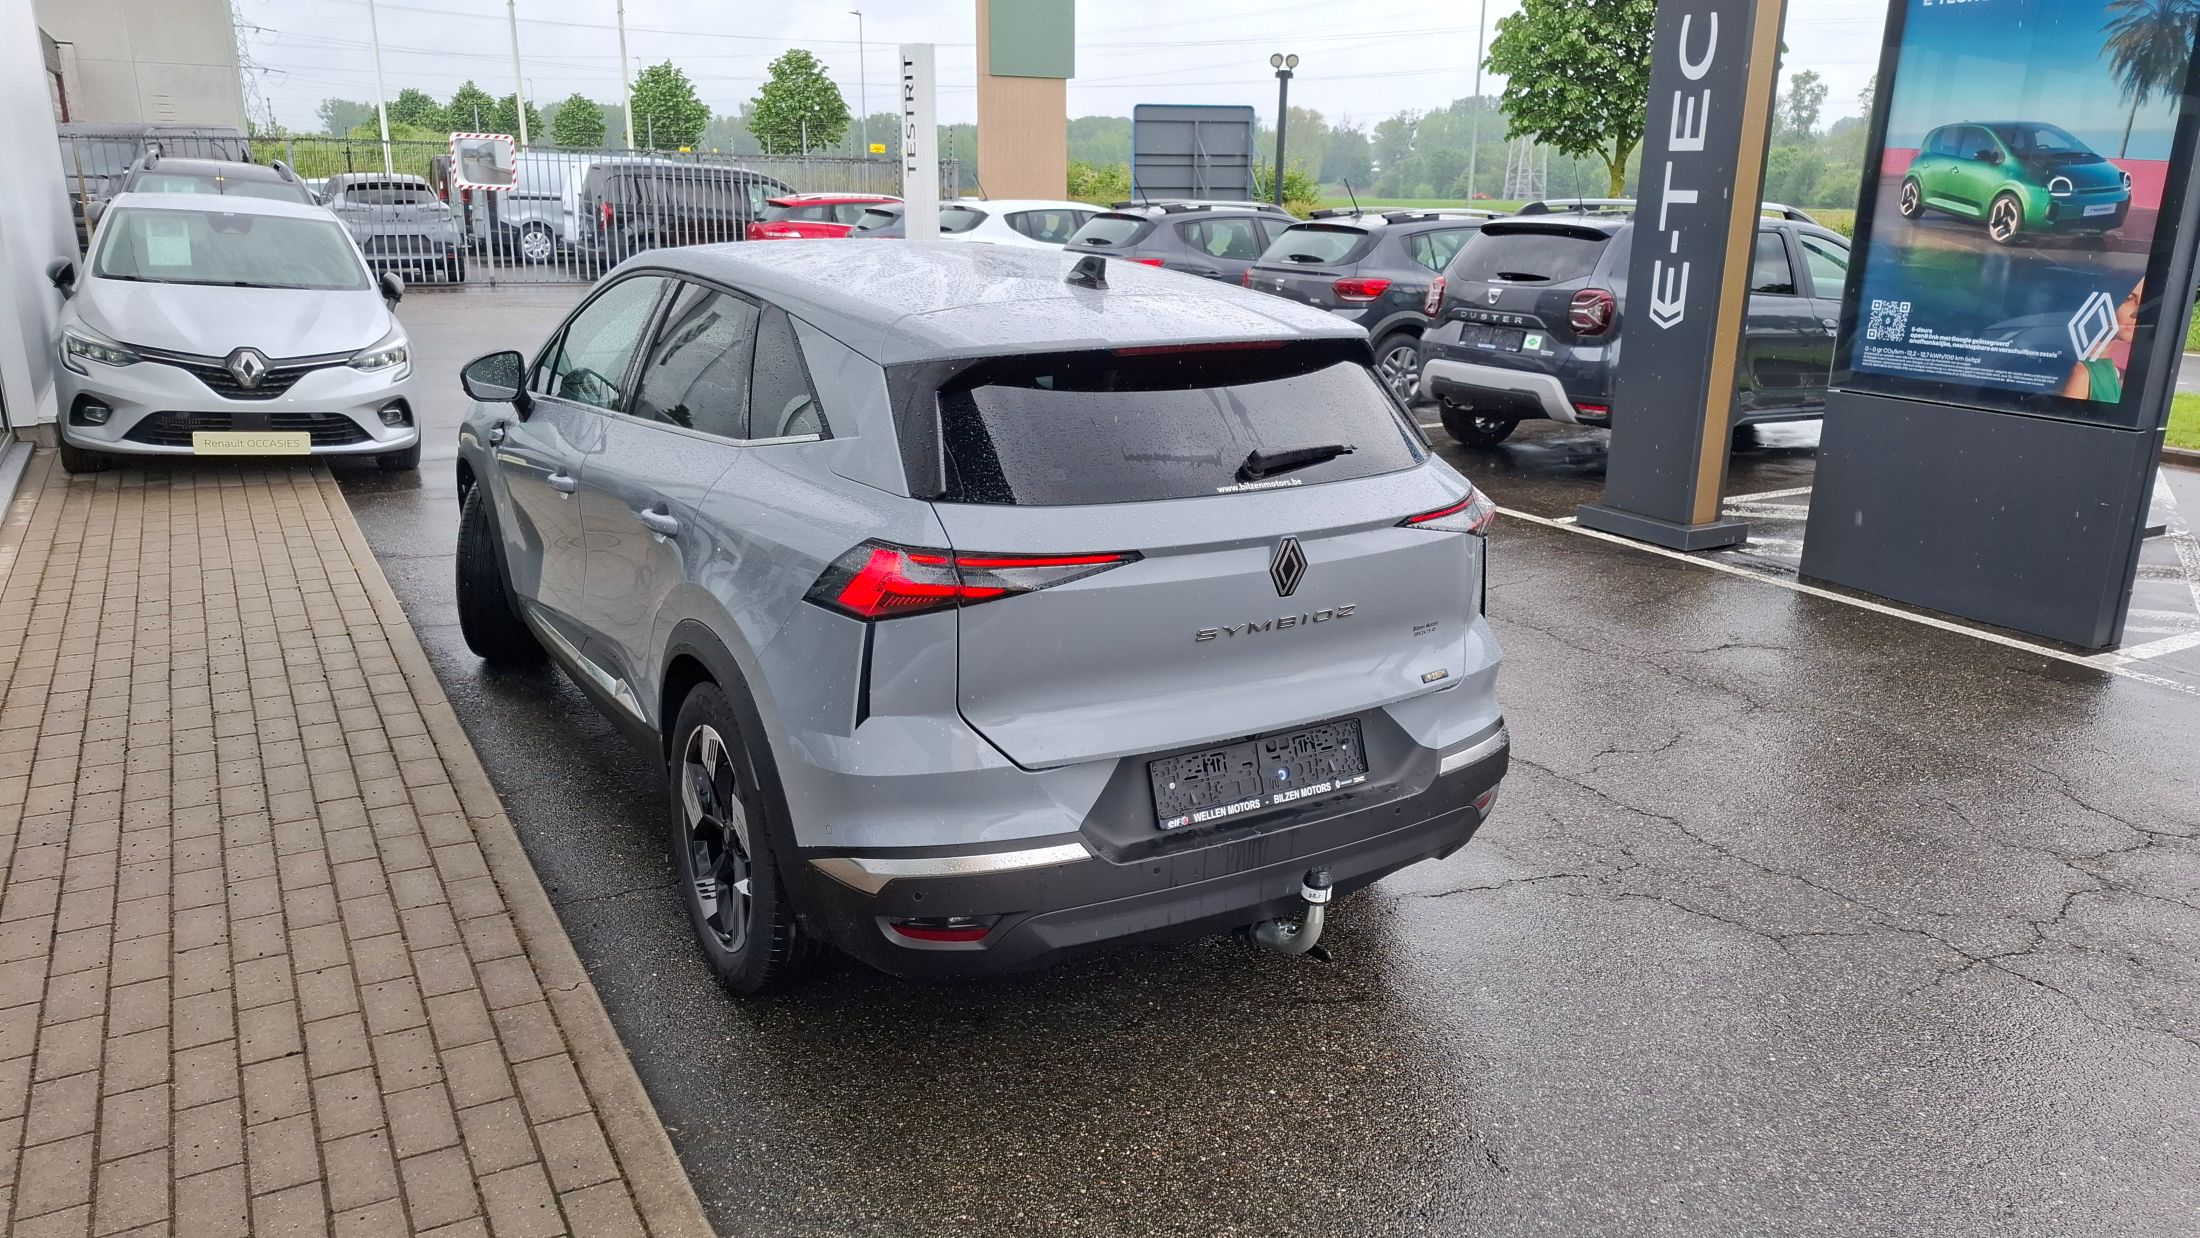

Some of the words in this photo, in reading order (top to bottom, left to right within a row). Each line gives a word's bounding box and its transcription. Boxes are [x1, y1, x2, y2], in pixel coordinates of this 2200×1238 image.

[903, 54, 917, 178] TESTRIT
[1460, 311, 1523, 325] DUSTER
[1951, 336, 1972, 345] Google
[204, 439, 244, 448] Renault
[246, 439, 300, 448] OCCASIES
[1216, 478, 1303, 493] www.bilzenmotors.be
[1195, 603, 1357, 642] SYMBIOZ
[1193, 806, 1227, 822] WELLEN
[1228, 799, 1261, 816] MOTORS
[1273, 790, 1300, 804] BILZEN
[1300, 782, 1332, 797] MOTORS
